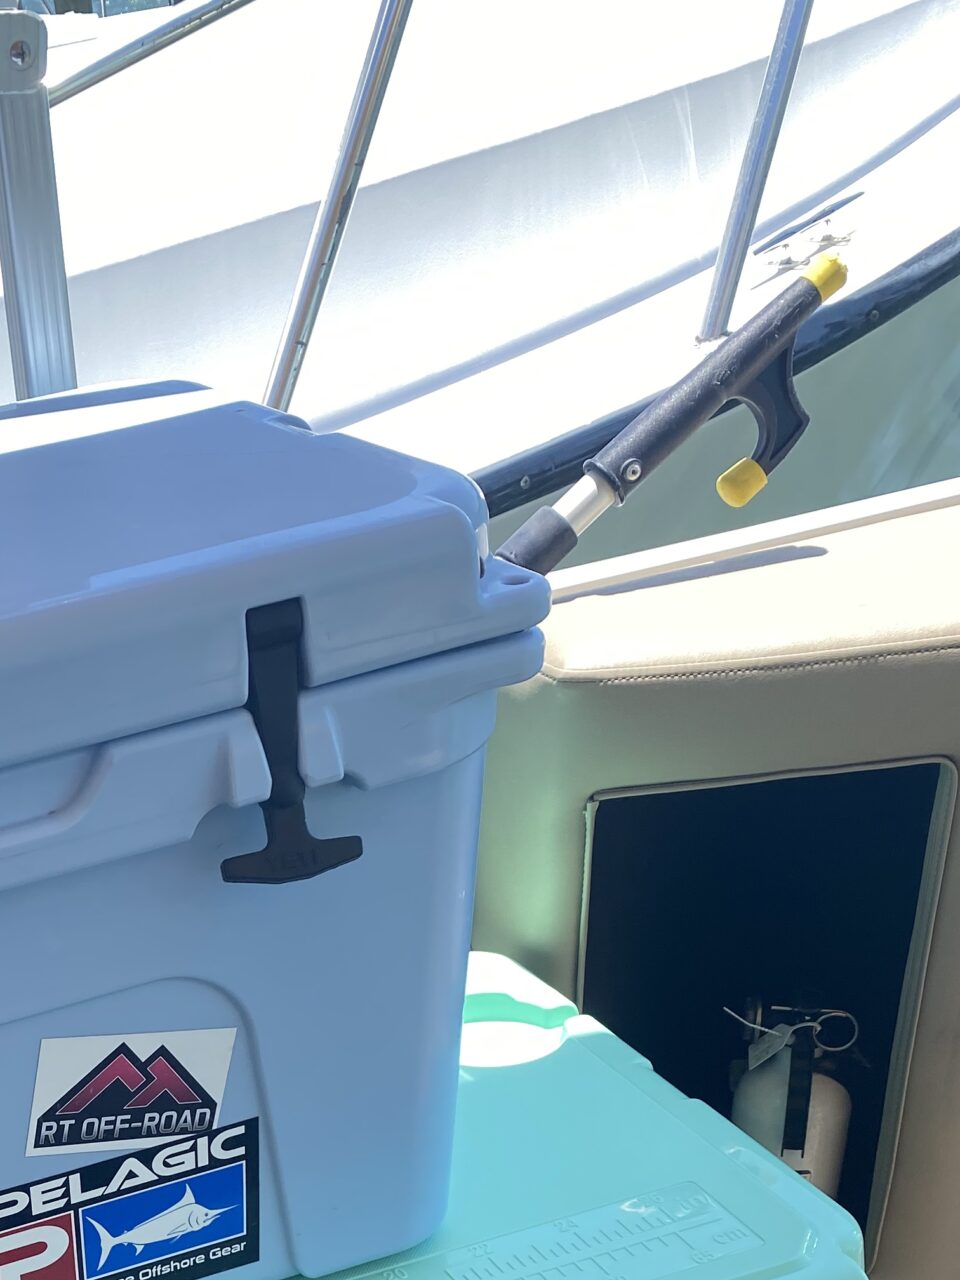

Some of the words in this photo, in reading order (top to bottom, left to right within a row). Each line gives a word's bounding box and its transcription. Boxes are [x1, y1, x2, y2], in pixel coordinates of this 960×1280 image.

[40, 1119, 78, 1145] RT
[81, 1107, 211, 1141] OFF-ROAD
[468, 1243, 495, 1258] 22
[553, 1218, 579, 1233] 24
[712, 1228, 749, 1246] cm
[139, 1253, 206, 1280] Offshore
[209, 1241, 247, 1260] Gear
